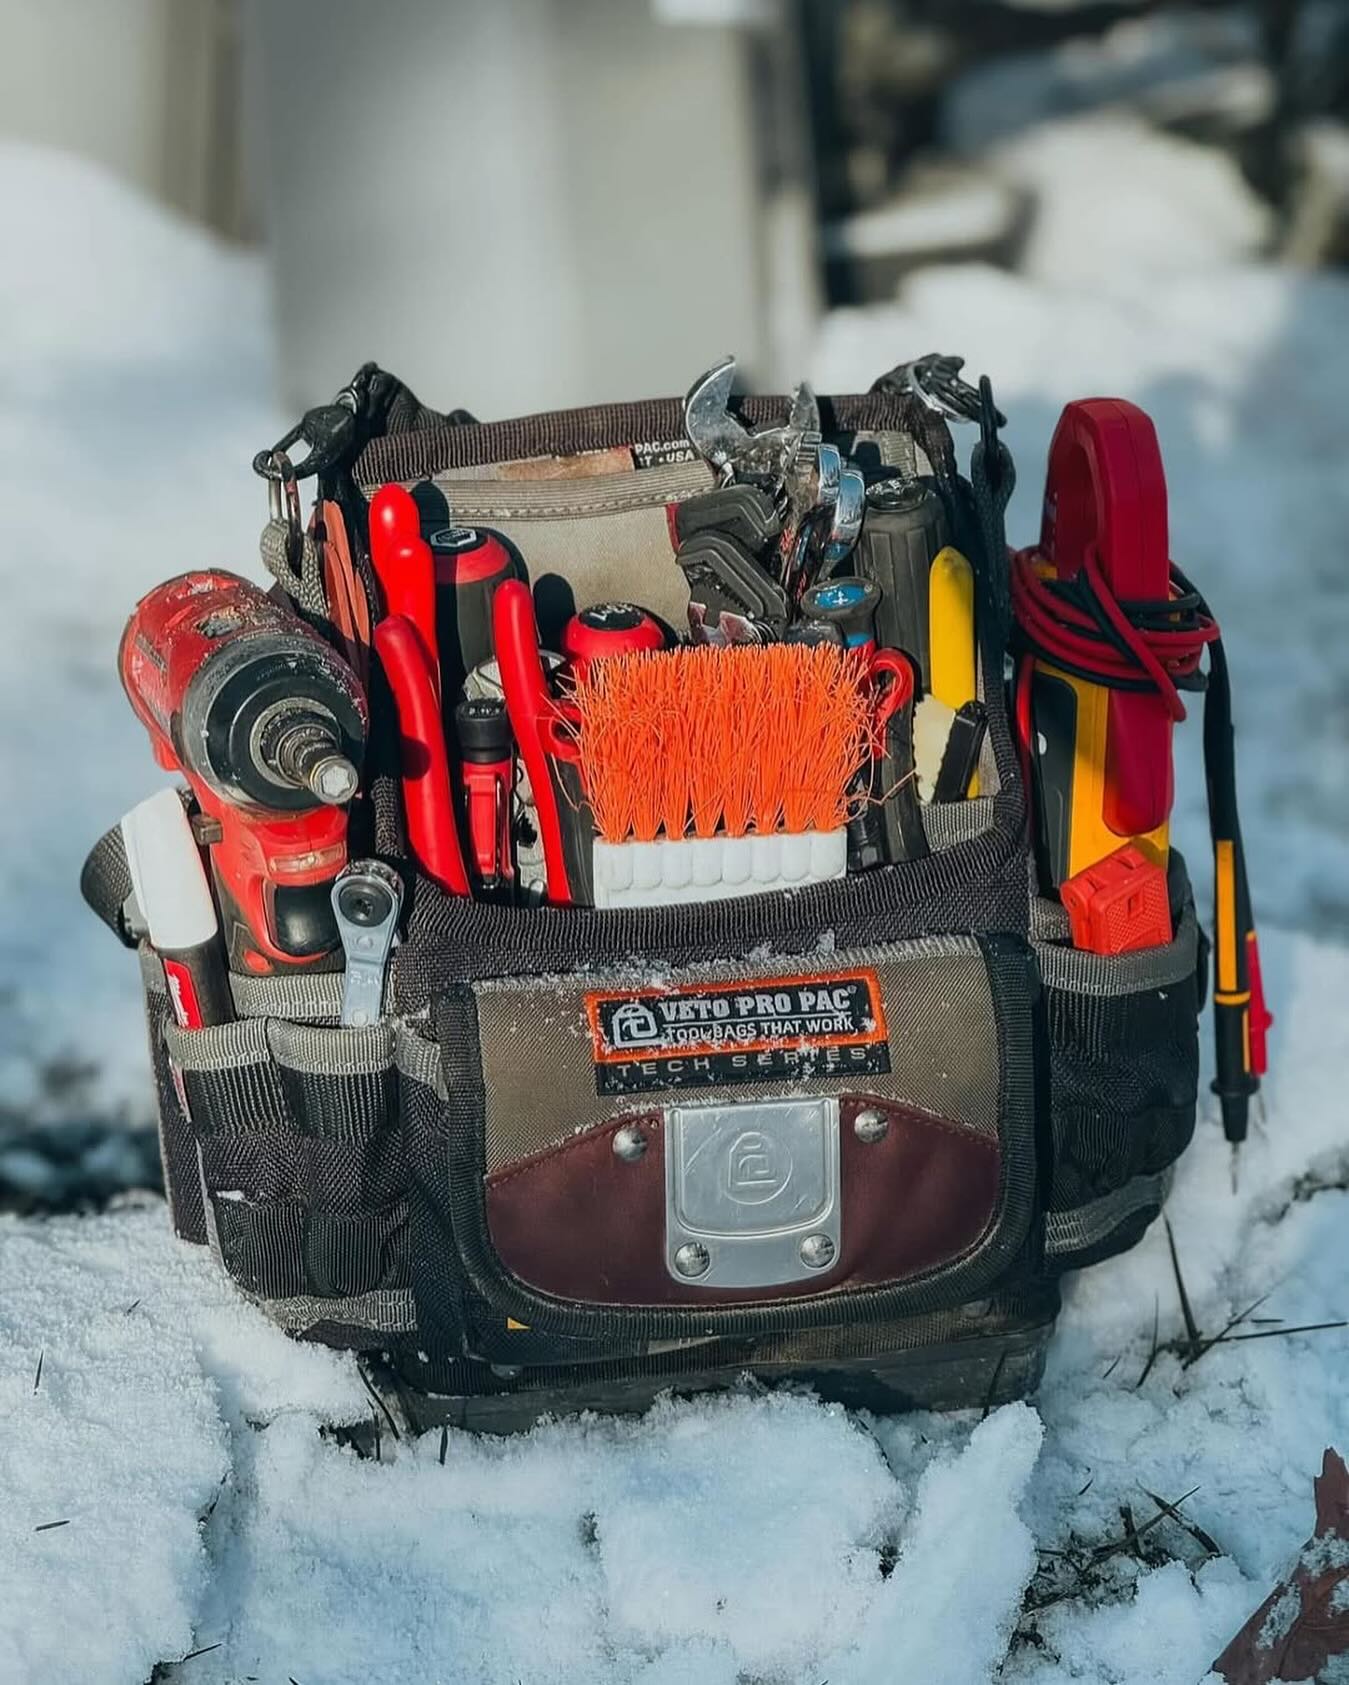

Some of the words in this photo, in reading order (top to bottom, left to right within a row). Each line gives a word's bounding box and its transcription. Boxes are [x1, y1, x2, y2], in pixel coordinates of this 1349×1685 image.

[666, 449, 695, 463] USA
[658, 999, 731, 1022] VETO
[735, 992, 792, 1017] PRO
[760, 1019, 802, 1035] THAT
[805, 1016, 854, 1034] WORK
[617, 1057, 711, 1077] TECH
[731, 1046, 867, 1068] SERIES
